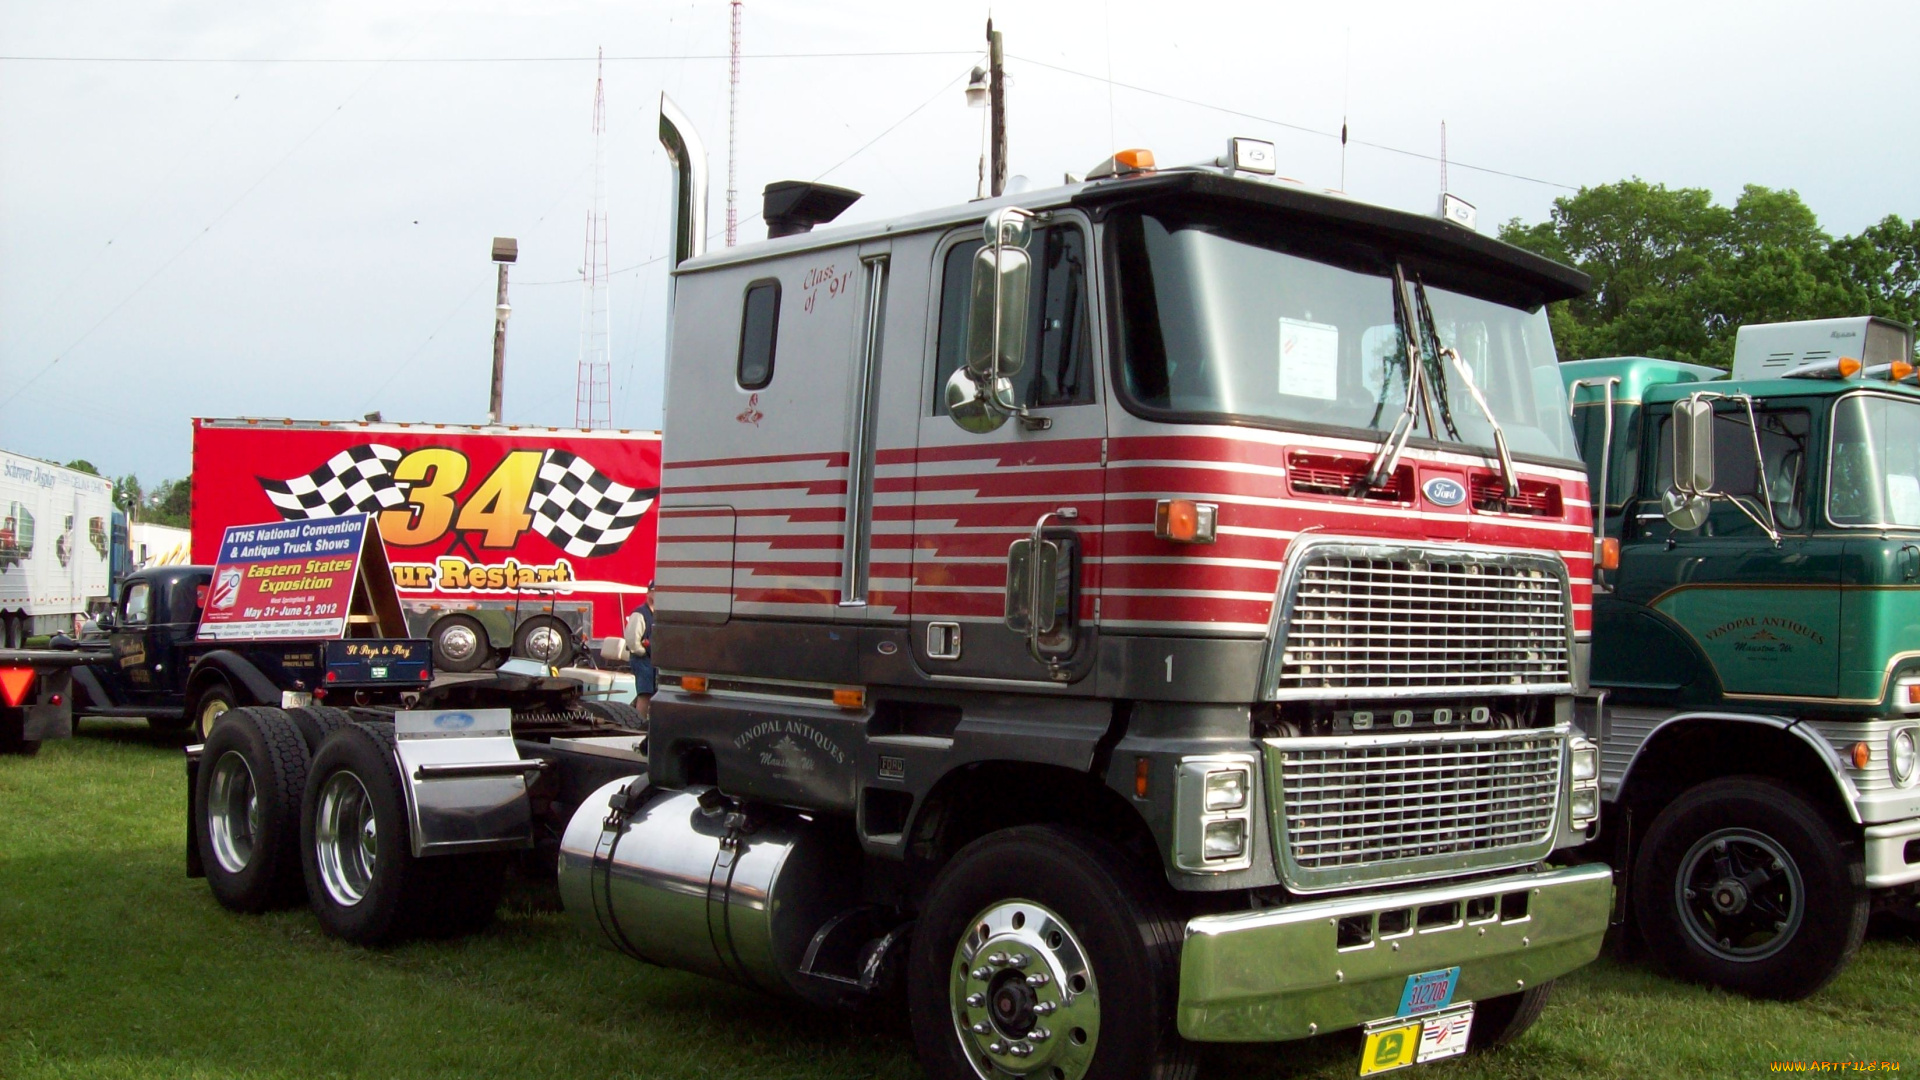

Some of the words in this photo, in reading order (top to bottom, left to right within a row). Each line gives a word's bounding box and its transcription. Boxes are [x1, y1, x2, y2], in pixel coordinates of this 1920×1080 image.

[804, 265, 834, 290] Class
[805, 288, 818, 314] of
[34, 466, 56, 490] Display
[377, 446, 544, 549] 34
[1434, 482, 1456, 499] Ford
[227, 529, 255, 544] ATHS
[257, 526, 301, 541] National
[302, 520, 361, 537] Convention
[230, 547, 239, 559] &
[240, 544, 280, 559] Antique
[283, 541, 313, 555] Truck
[315, 538, 350, 552] Shows
[247, 563, 302, 578] Eastern
[305, 559, 353, 574] States
[440, 559, 569, 590] Restart
[258, 576, 333, 595] Exposition
[244, 607, 262, 619] May
[304, 604, 312, 617] 2,
[315, 603, 338, 615] 2012
[1705, 617, 1758, 641] VINOPAL
[1762, 617, 1826, 645] ANTIQUES
[359, 644, 379, 659] Pays
[381, 645, 390, 655] to
[1165, 654, 1174, 682] 1
[1352, 707, 1490, 730] 9000
[733, 720, 782, 750] VINOPAL
[785, 720, 846, 765] ANTIQUES
[882, 758, 903, 771] FORD
